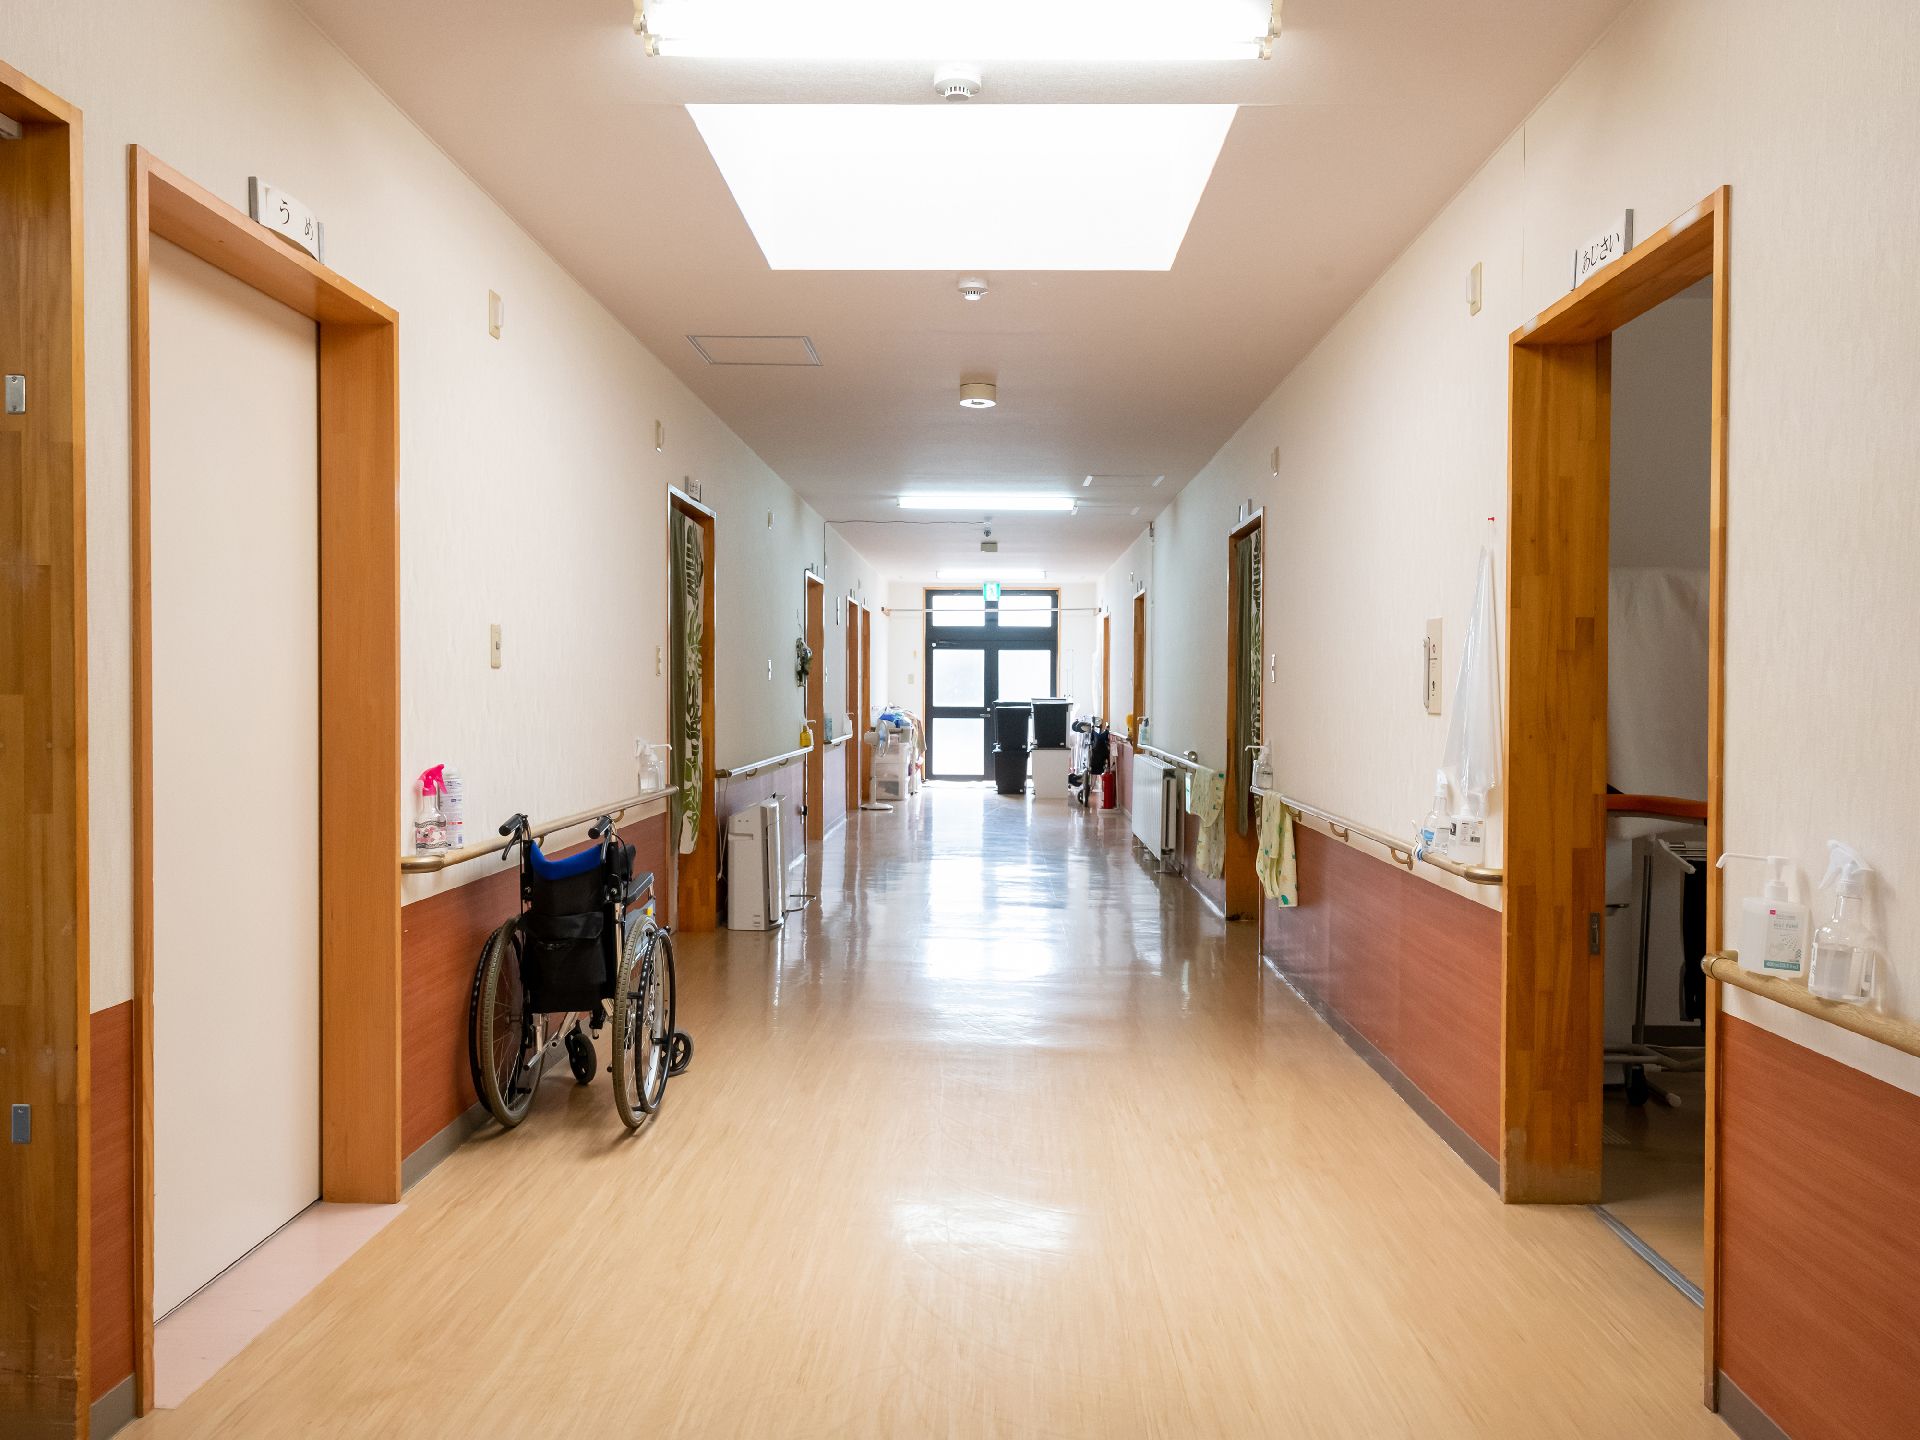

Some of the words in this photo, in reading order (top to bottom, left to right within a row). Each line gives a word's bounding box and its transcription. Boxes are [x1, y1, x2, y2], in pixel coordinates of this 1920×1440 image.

[279, 198, 314, 241] うめ
[1581, 232, 1620, 274] あじさい
